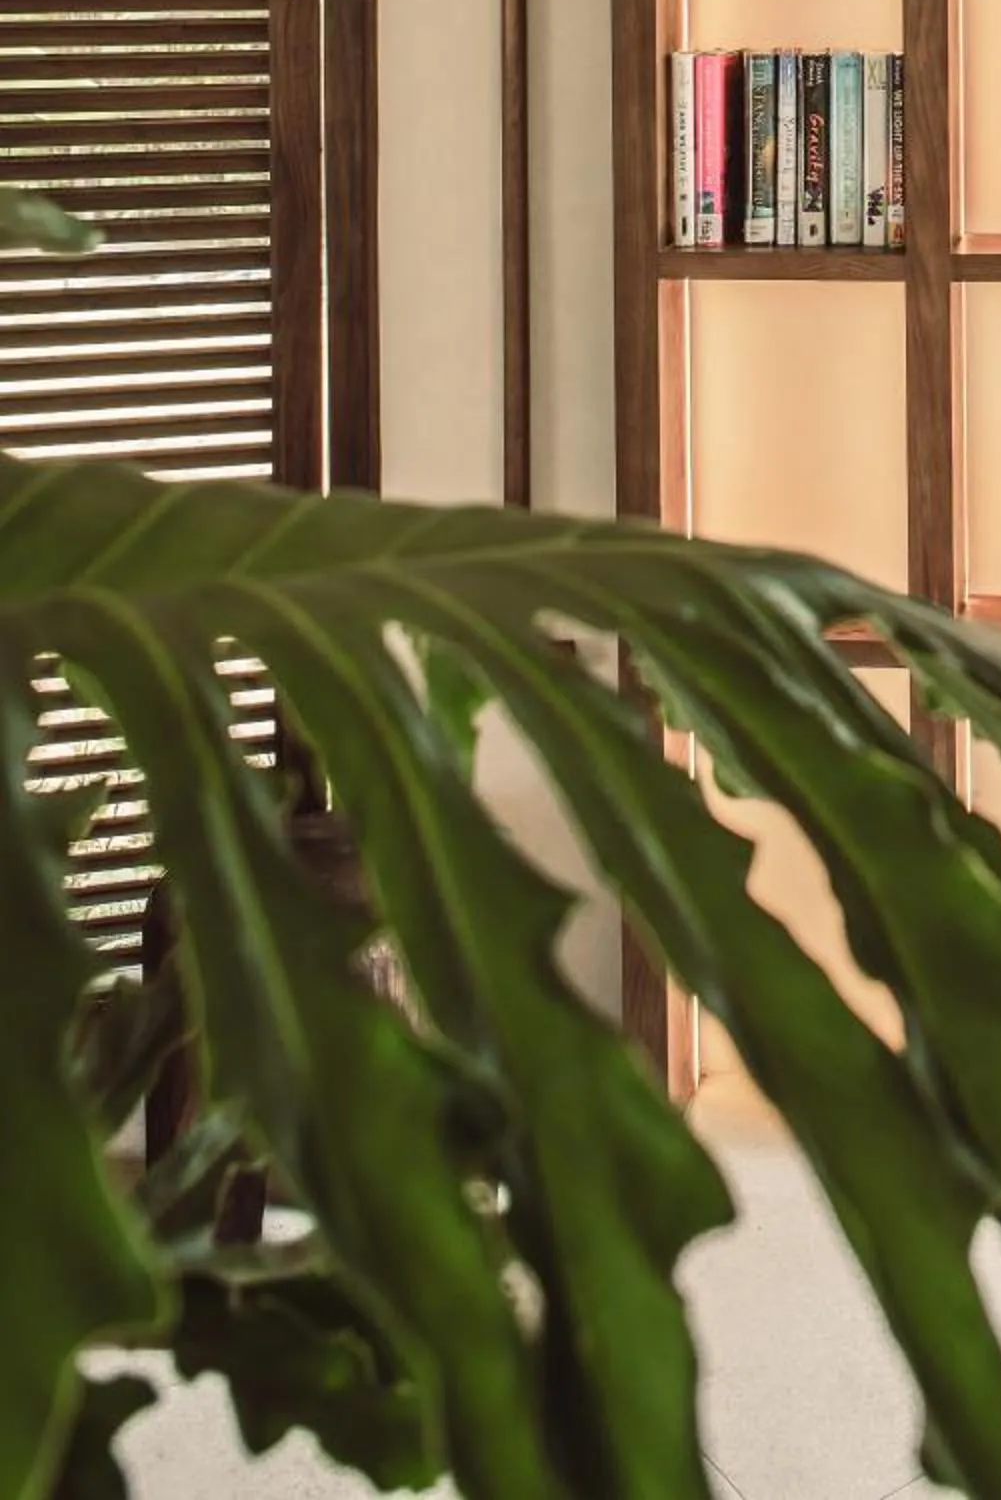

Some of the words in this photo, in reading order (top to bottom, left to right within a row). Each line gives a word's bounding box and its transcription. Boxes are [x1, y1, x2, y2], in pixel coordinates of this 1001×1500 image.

[893, 89, 903, 107] WE
[893, 110, 903, 142] LIGHT
[805, 113, 825, 184] Gravity
[893, 144, 903, 161] UP
[893, 163, 903, 183] THE
